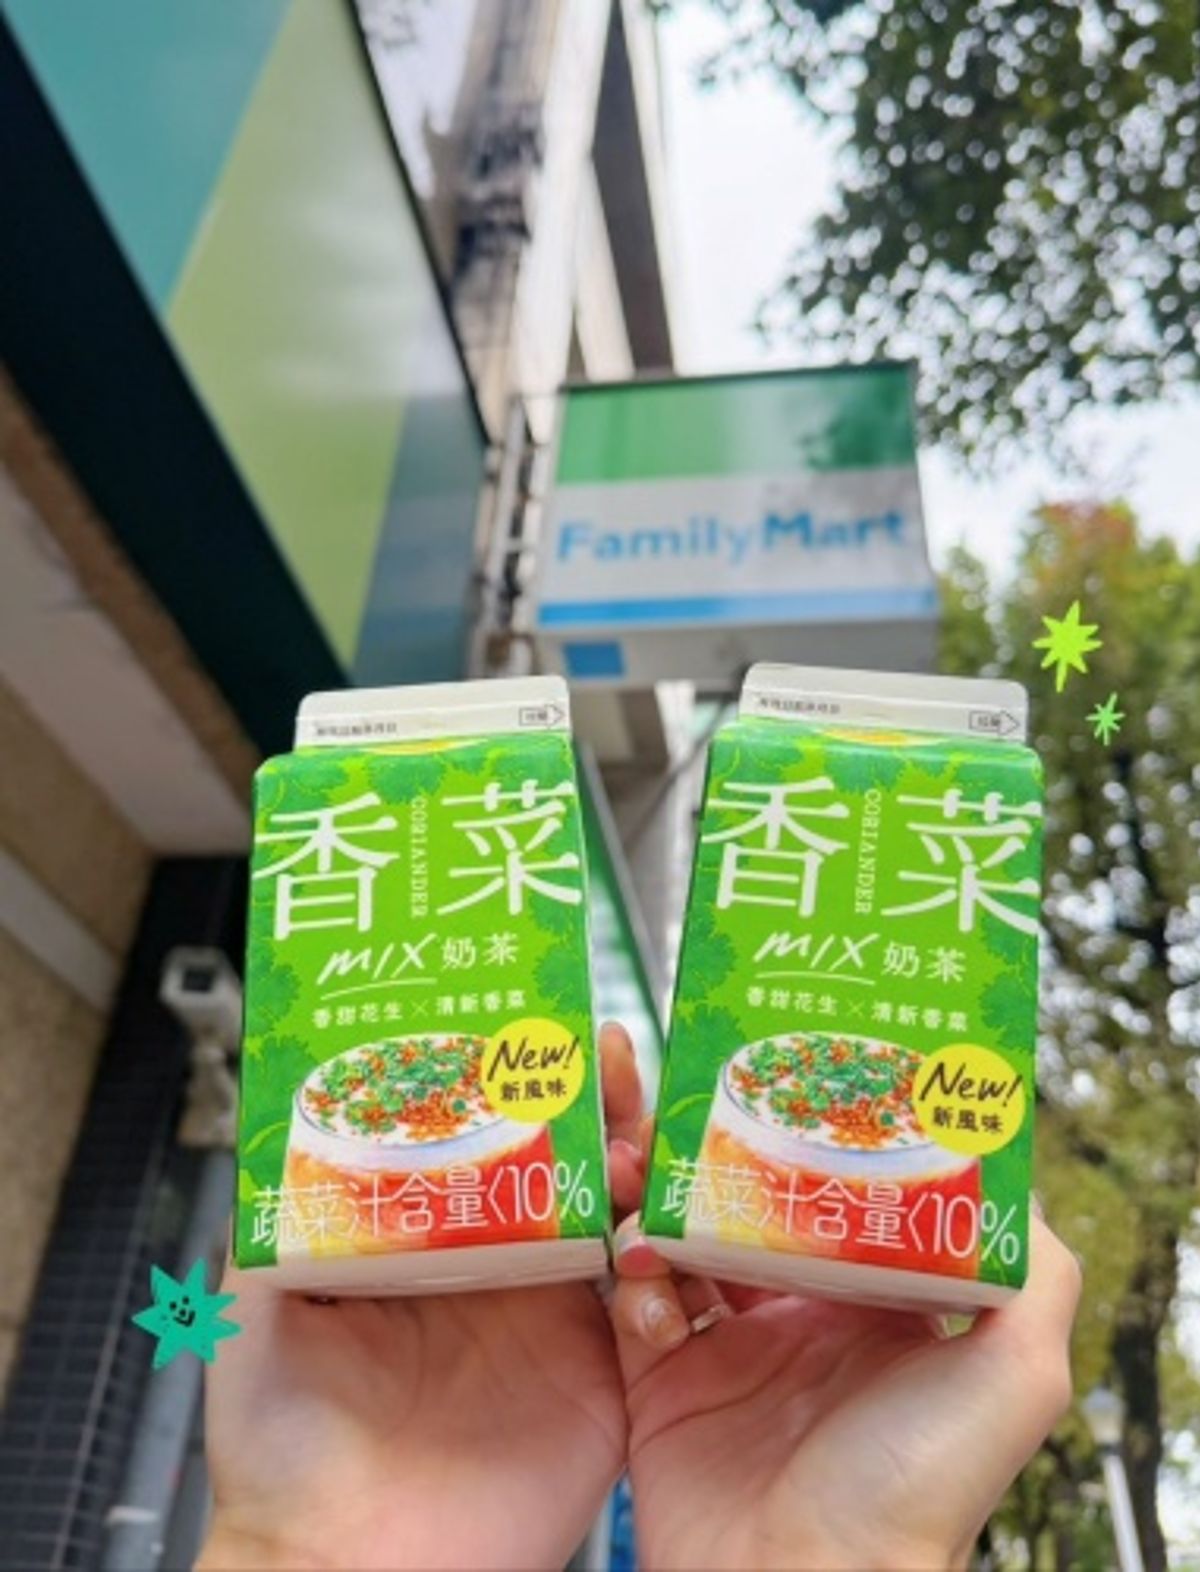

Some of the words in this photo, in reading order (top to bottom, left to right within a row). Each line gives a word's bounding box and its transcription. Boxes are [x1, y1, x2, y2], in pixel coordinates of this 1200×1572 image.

[557, 509, 905, 563] FamilyMart
[252, 779, 582, 940] 香菜
[411, 797, 428, 918] CORIANDER
[701, 777, 1042, 935] 香菜
[855, 788, 881, 914] CORIANDER
[317, 933, 437, 985] MIX
[441, 931, 519, 969] 奶茶
[754, 931, 879, 972] MIX
[882, 942, 966, 984] 奶茶
[487, 1036, 579, 1082] New!
[919, 1061, 1022, 1108] New!
[500, 1078, 567, 1102] 新風味
[932, 1106, 1003, 1134] 新風味
